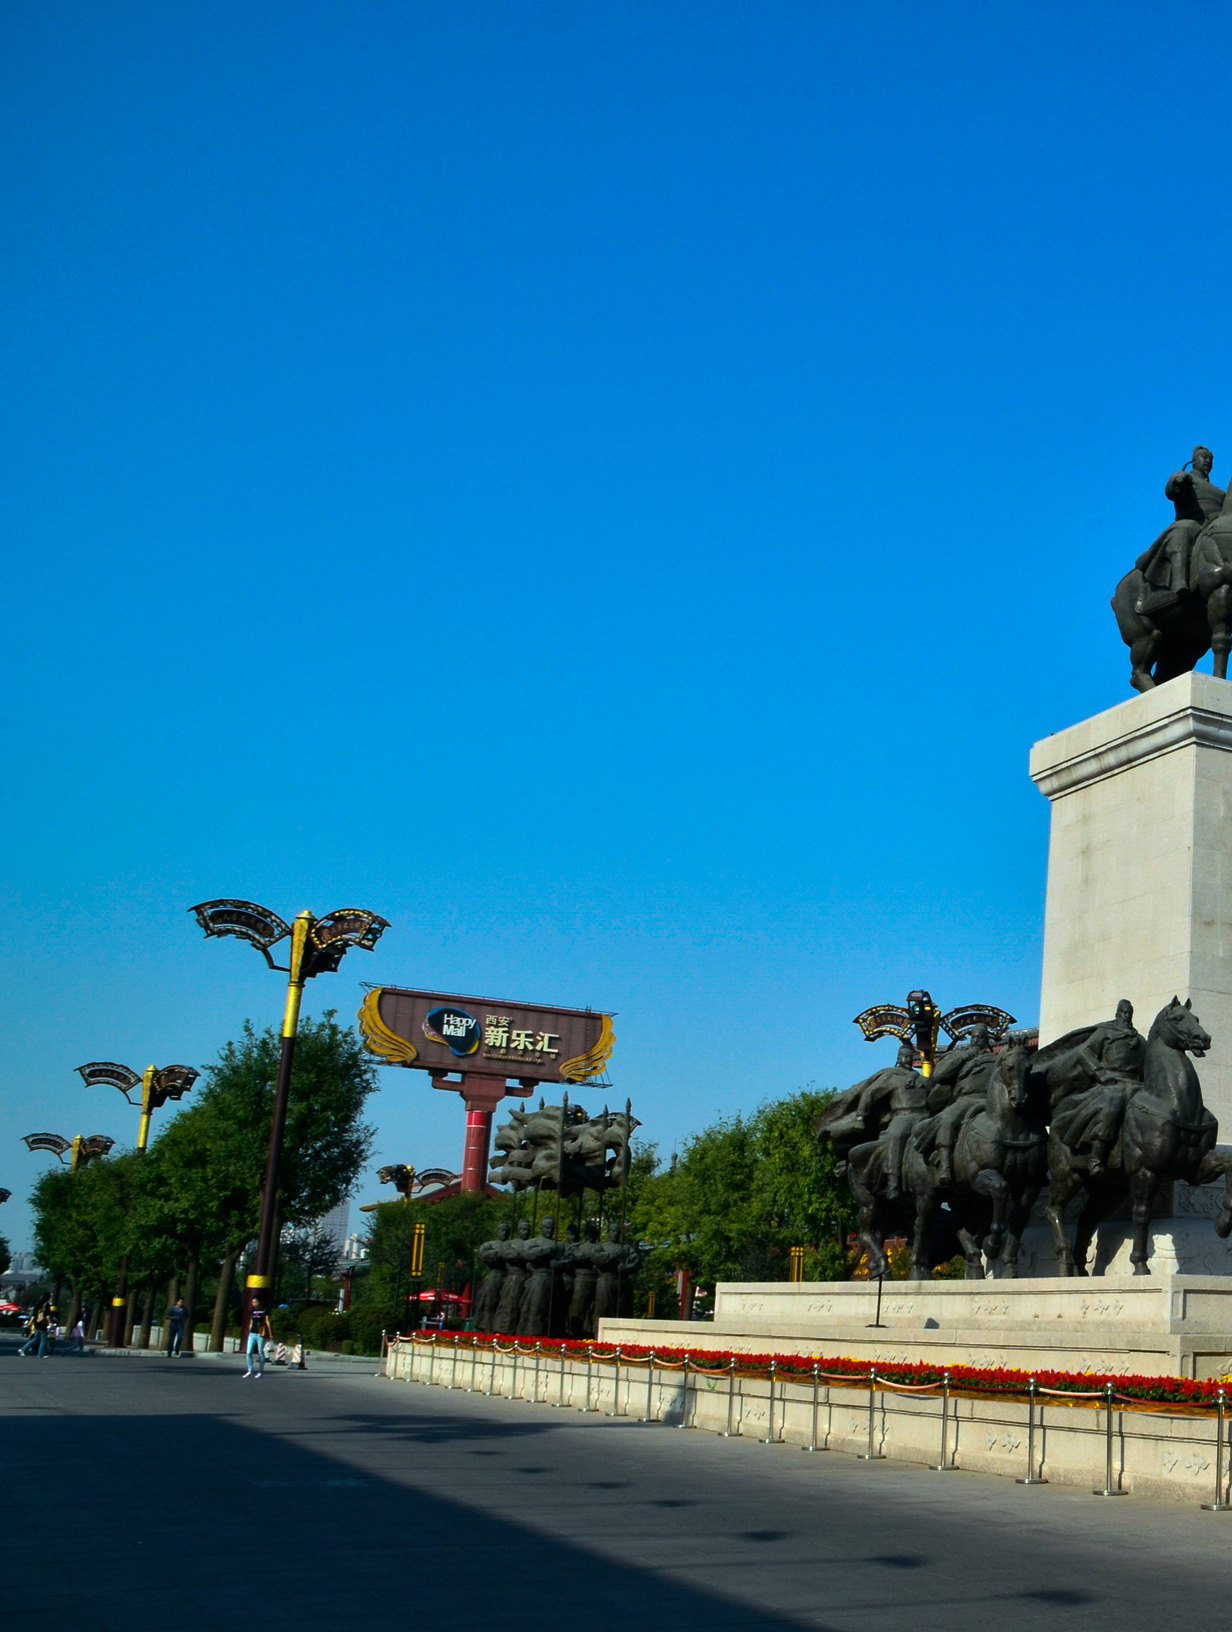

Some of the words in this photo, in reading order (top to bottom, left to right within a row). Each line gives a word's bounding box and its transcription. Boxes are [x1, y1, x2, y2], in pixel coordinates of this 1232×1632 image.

[443, 1013, 477, 1029] Happy
[485, 1014, 511, 1026] 西安
[442, 1024, 466, 1037] Mall
[484, 1026, 560, 1053] 新乐汇
